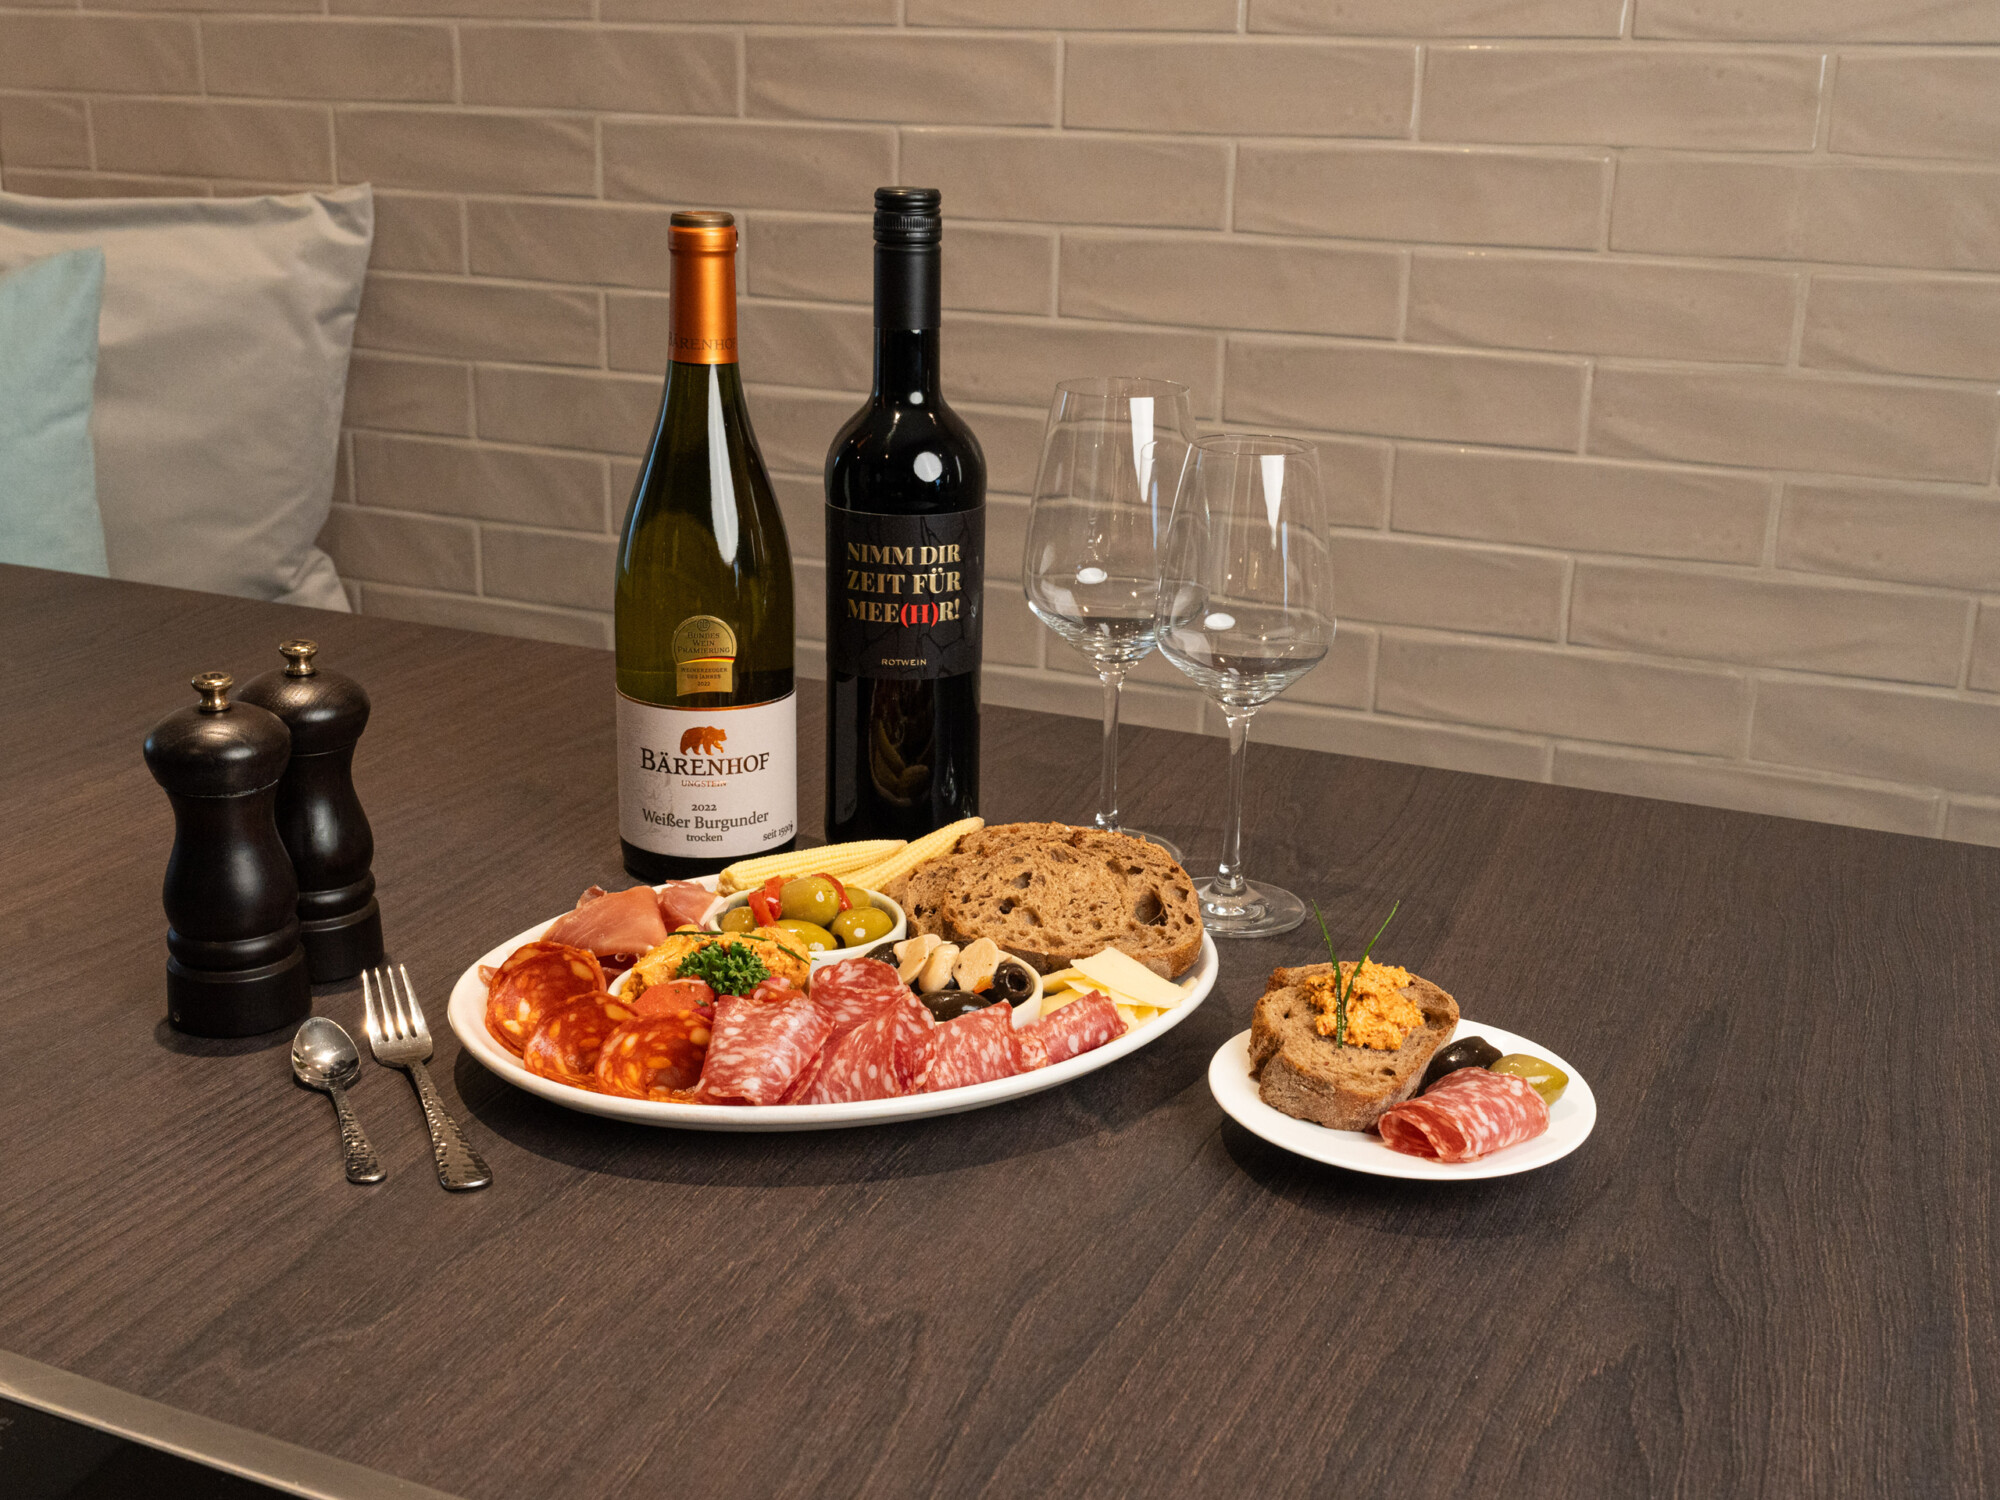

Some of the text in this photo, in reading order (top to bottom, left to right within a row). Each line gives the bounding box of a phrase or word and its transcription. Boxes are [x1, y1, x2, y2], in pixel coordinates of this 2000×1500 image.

[847, 541, 961, 566] NIMM DIR
[847, 567, 962, 595] ZEIT FÜR
[847, 598, 961, 628] MEE(H)R!
[687, 631, 720, 639] BUNDES
[692, 639, 715, 647] WEIN
[881, 658, 927, 666] ROTWEIN
[640, 747, 770, 776] BÄRENHOF
[691, 803, 717, 812] 2022
[642, 808, 769, 831] Weißer Burgunder
[686, 833, 723, 842] trocken
[762, 828, 777, 841] seit
